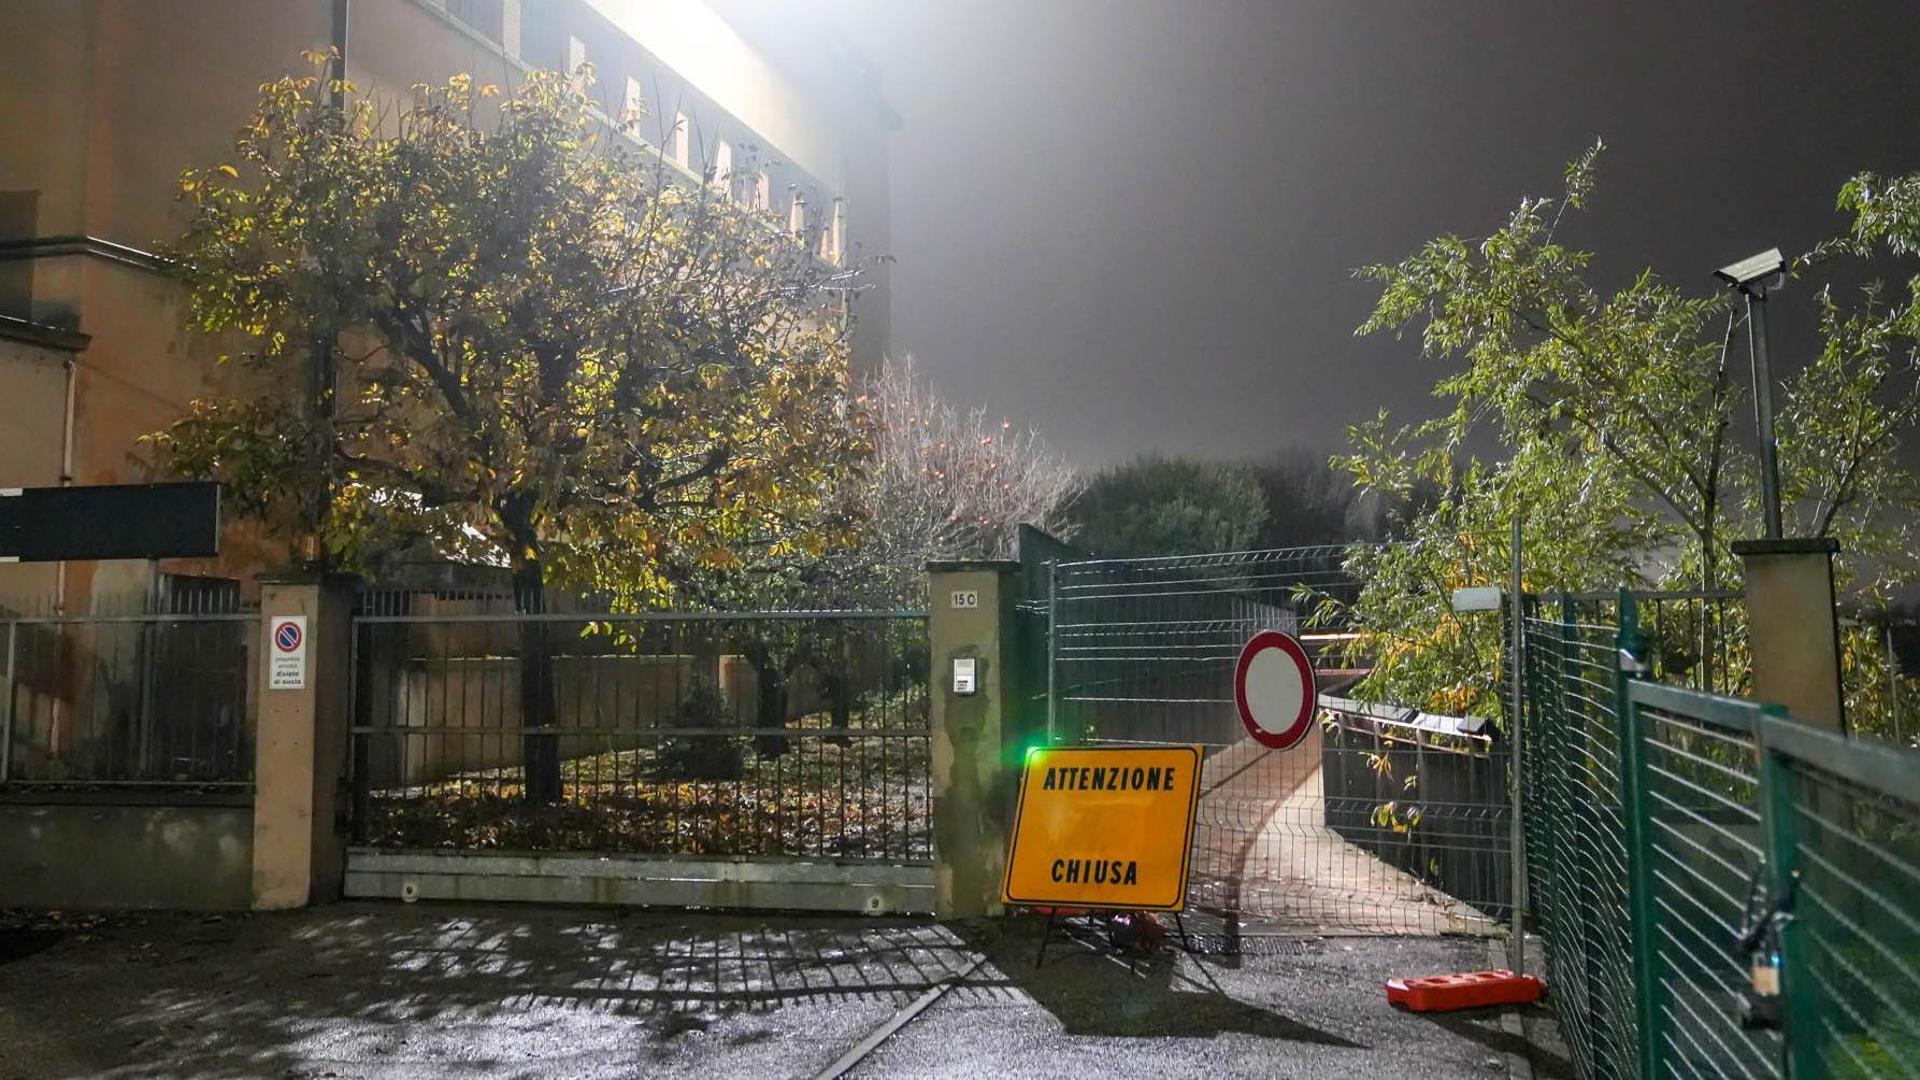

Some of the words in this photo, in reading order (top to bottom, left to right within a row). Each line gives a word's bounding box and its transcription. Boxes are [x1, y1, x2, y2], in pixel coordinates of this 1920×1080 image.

[954, 593, 965, 606] 15
[1042, 767, 1176, 791] ATTENZIONE
[1051, 858, 1138, 886] CHIUSA
